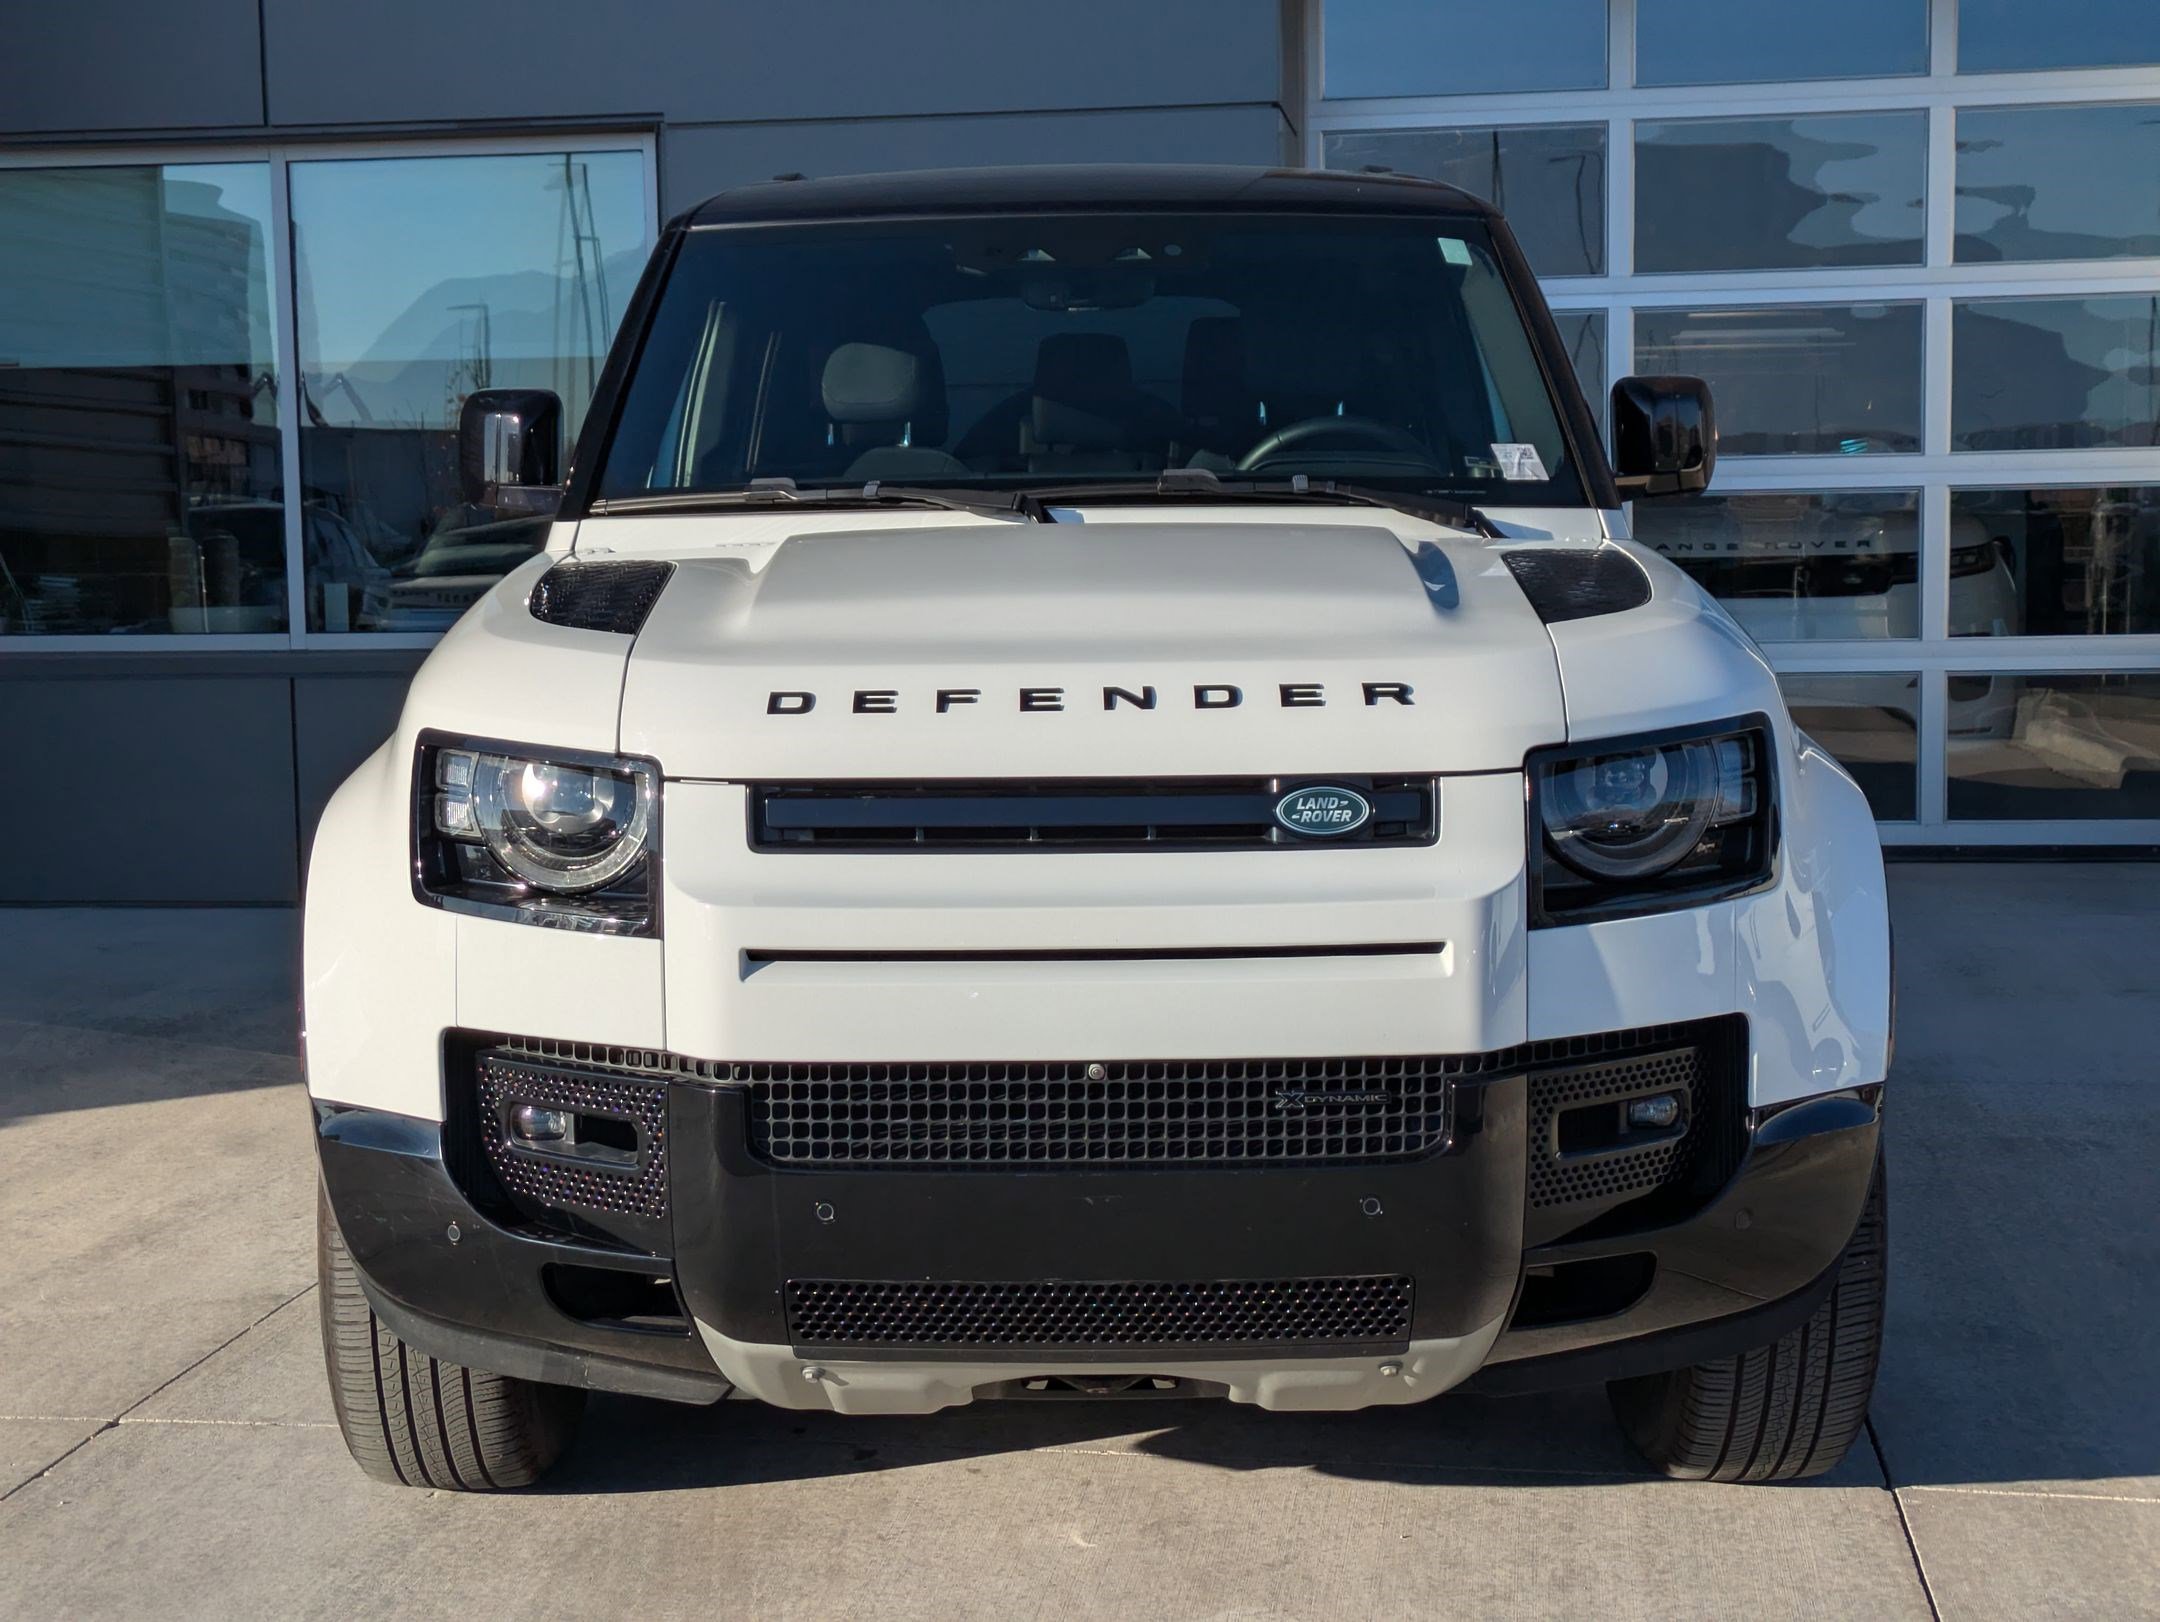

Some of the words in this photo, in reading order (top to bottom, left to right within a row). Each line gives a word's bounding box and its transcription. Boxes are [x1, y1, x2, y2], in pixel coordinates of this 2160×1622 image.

[1655, 543, 1739, 551] ANGE
[766, 682, 1416, 714] DEFENDER
[1305, 1094, 1388, 1104] DYNAMIC
